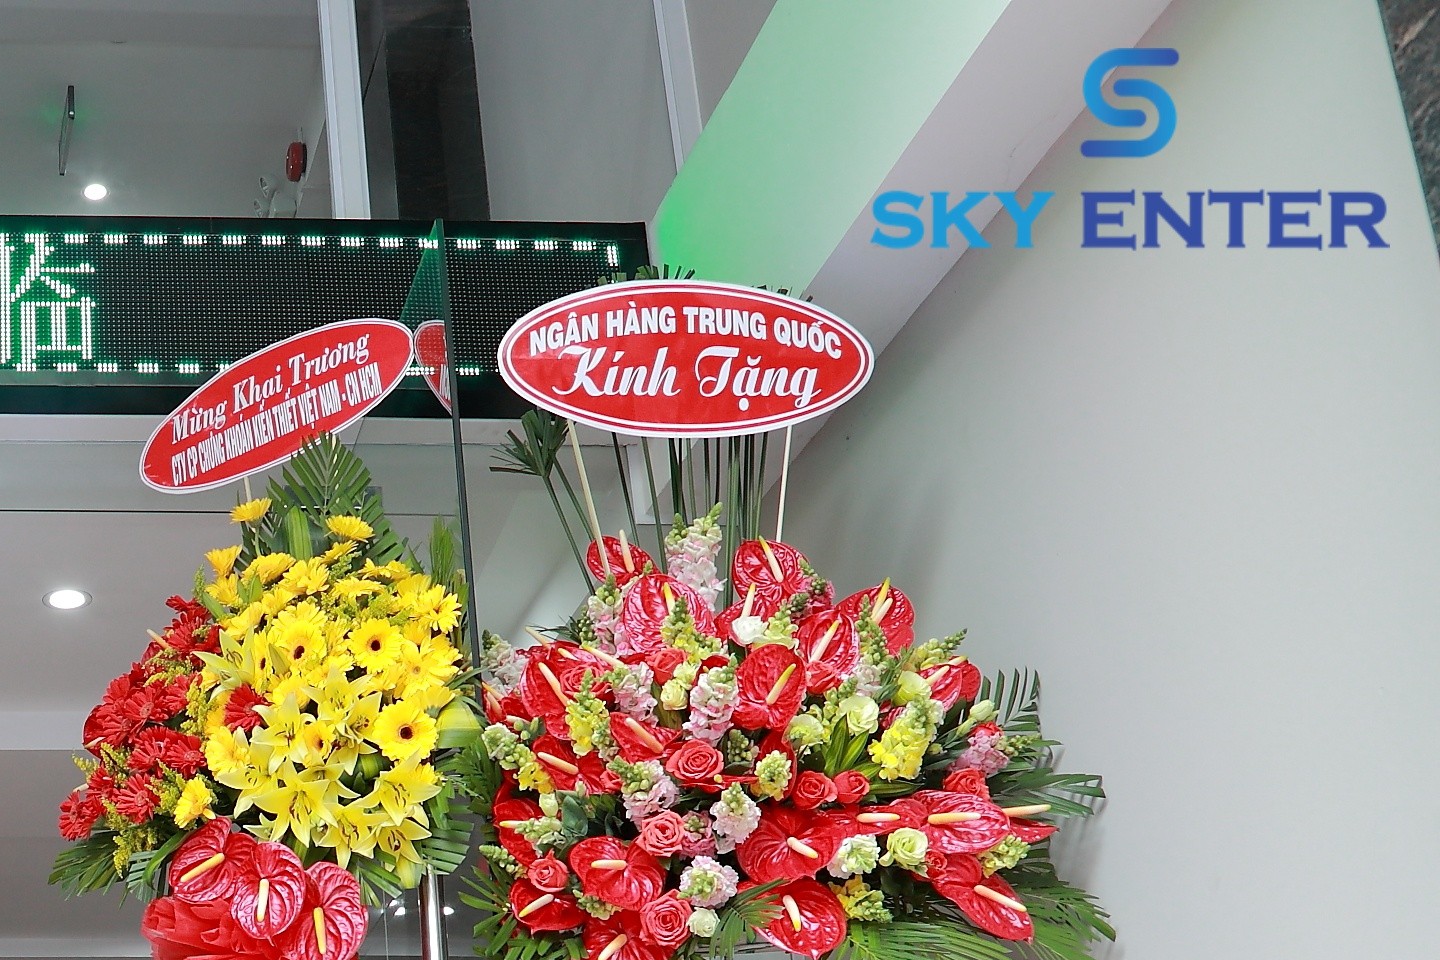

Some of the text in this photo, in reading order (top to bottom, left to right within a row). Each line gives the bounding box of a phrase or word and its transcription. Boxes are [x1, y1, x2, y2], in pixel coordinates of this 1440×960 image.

[528, 301, 842, 360] NGÂN HÀNG TRUNG QUỐC
[170, 333, 371, 446] Mừng Khai Trương
[551, 345, 822, 411] Kính Tặng
[171, 453, 189, 487] CTY
[186, 447, 200, 480] CP
[225, 415, 255, 464] KHOÁN
[253, 400, 276, 449] KIẾN
[274, 385, 299, 442] THIẾT
[298, 383, 320, 430] VIỆT
[318, 382, 343, 421] NAM
[344, 372, 361, 409] CN
[358, 361, 384, 404] HCM
